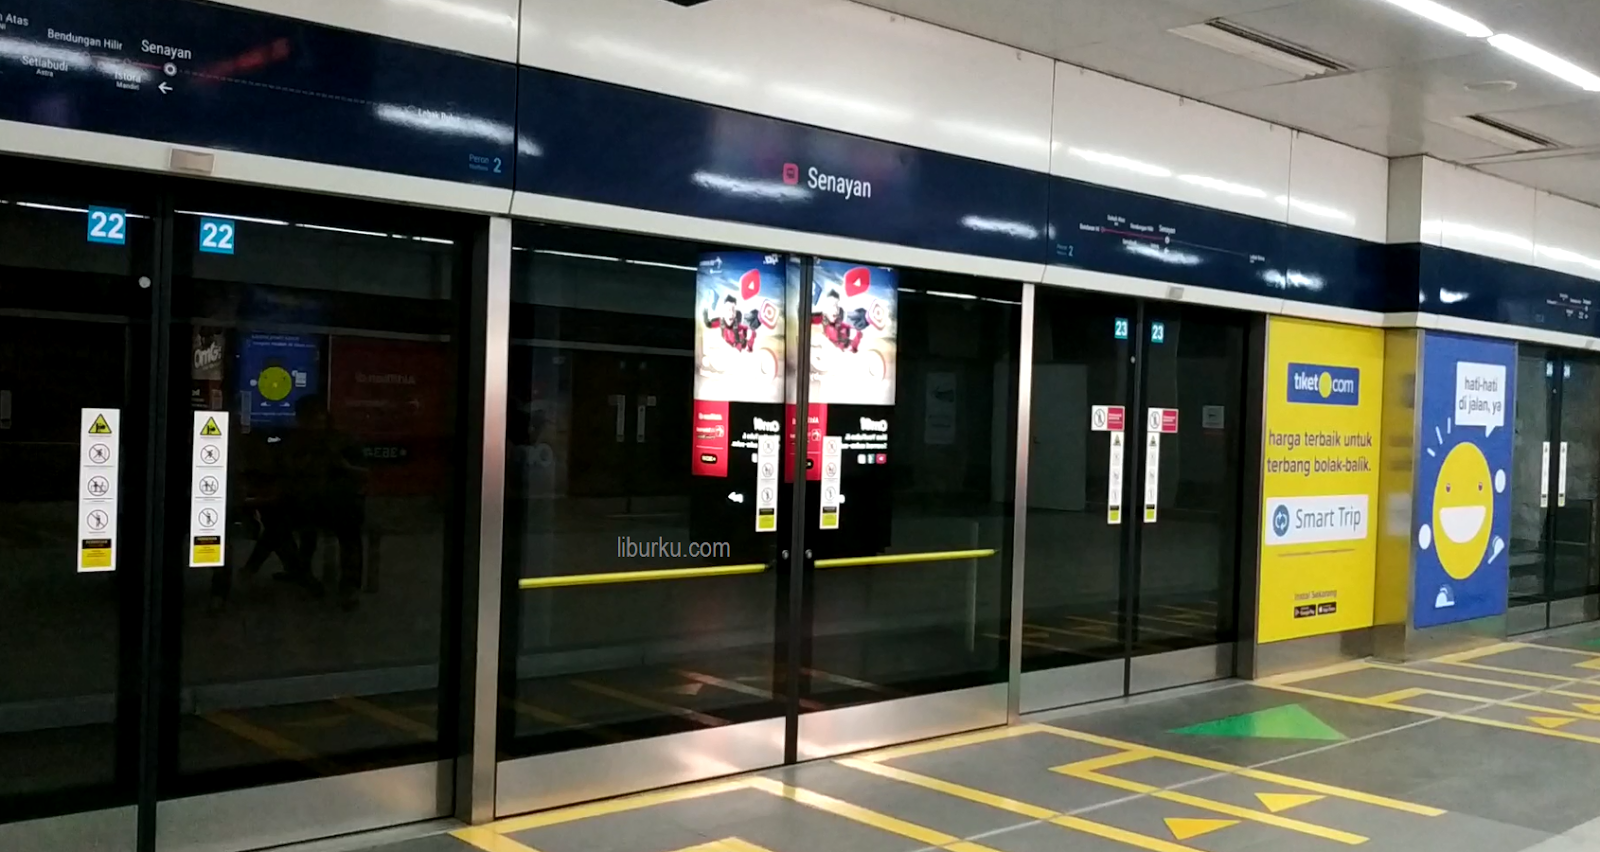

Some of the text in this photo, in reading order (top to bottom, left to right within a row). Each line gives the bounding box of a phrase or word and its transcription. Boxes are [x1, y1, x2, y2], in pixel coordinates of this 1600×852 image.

[5, 13, 29, 27] Atas
[47, 28, 123, 51] Bendungan Hilir
[141, 38, 192, 60] Senayan
[22, 55, 68, 71] Setiabudi
[493, 157, 502, 174] 2
[807, 166, 872, 200] Senayan
[90, 211, 124, 240] 22
[202, 222, 233, 249] 22
[1115, 320, 1128, 337] 23
[1152, 324, 1164, 340] 23
[1464, 376, 1498, 392] hati-hati
[1458, 396, 1468, 410] di
[1492, 402, 1502, 415] ya
[1268, 430, 1372, 451] harga terbaik untuk
[1266, 456, 1371, 477] terbang bolak-balik.
[1295, 505, 1361, 532] Smart Trip
